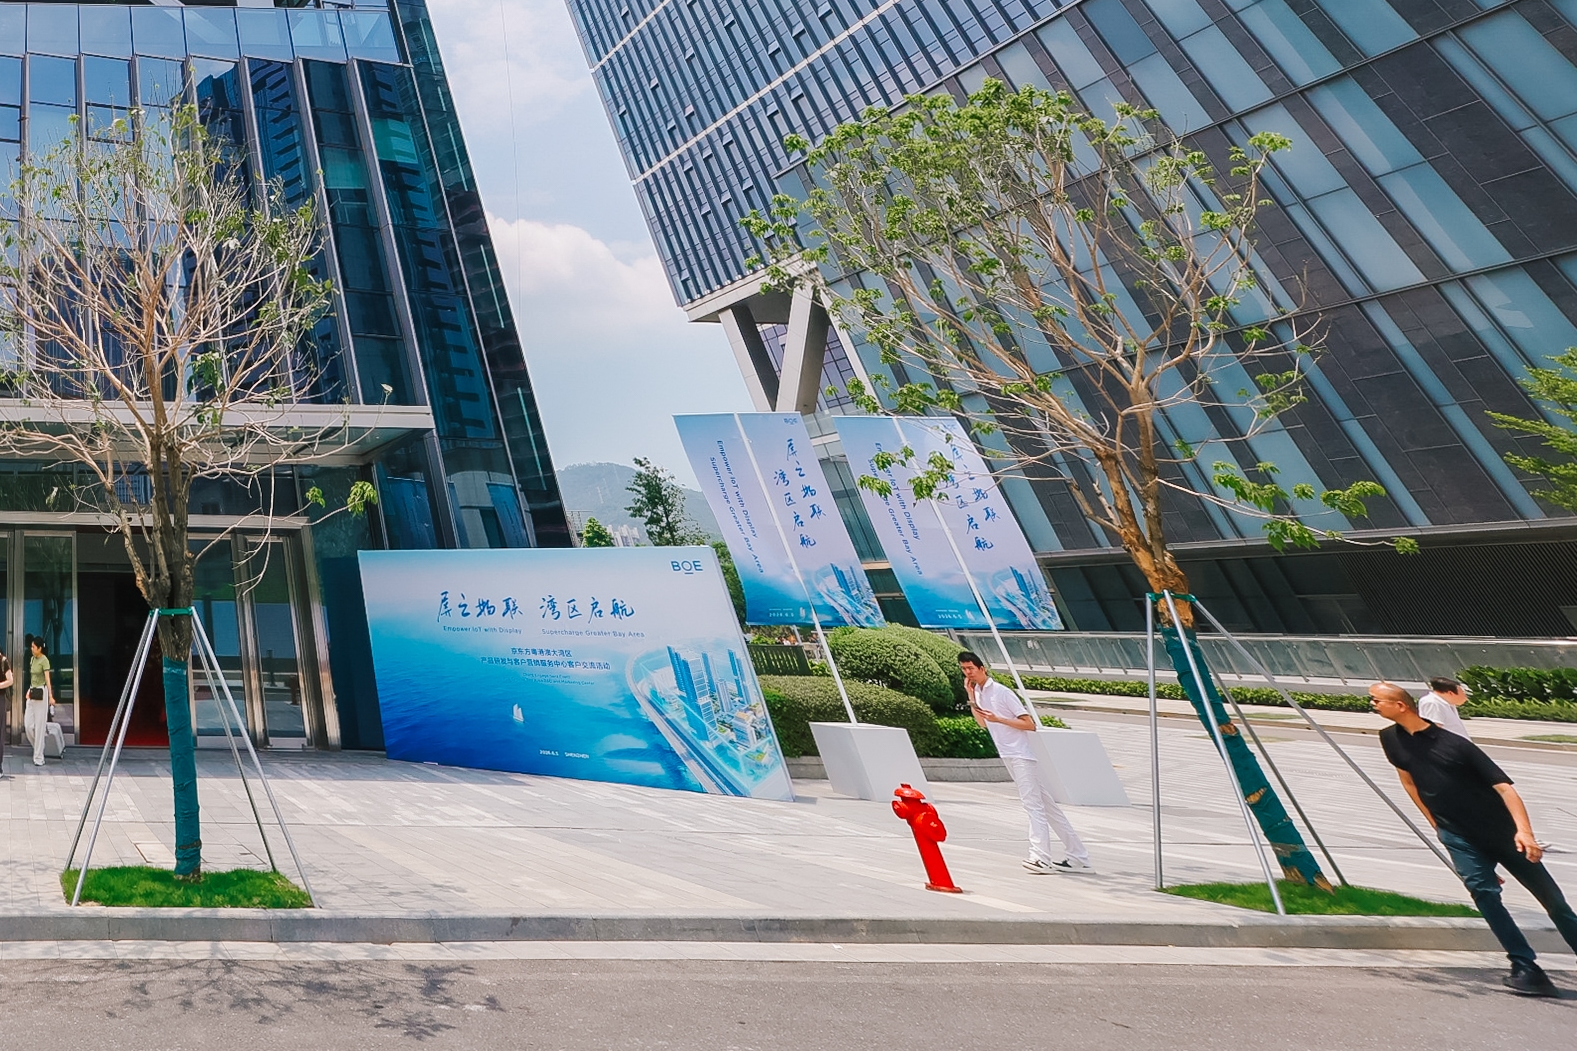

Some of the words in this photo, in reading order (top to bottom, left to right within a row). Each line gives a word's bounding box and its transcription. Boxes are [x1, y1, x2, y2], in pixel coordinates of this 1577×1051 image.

[710, 457, 731, 506] Supercharge
[729, 506, 745, 535] Greater
[744, 537, 754, 552] Bay
[753, 554, 764, 573] Area
[717, 440, 733, 476] Empower
[730, 475, 739, 489] IoT
[735, 491, 745, 507] with
[742, 509, 758, 539] Display
[773, 469, 816, 549] 湾区启航
[890, 479, 900, 491] IoT
[896, 493, 906, 510] with
[903, 511, 921, 541] Display
[670, 559, 703, 575] BOE
[888, 508, 904, 537] Greater
[902, 539, 912, 554] Bay
[910, 556, 923, 575] Area
[443, 625, 471, 633] Empower
[498, 627, 522, 635] Display
[539, 594, 636, 624] 湾区启航
[541, 629, 583, 637] Supercharge
[612, 630, 626, 638] Bay
